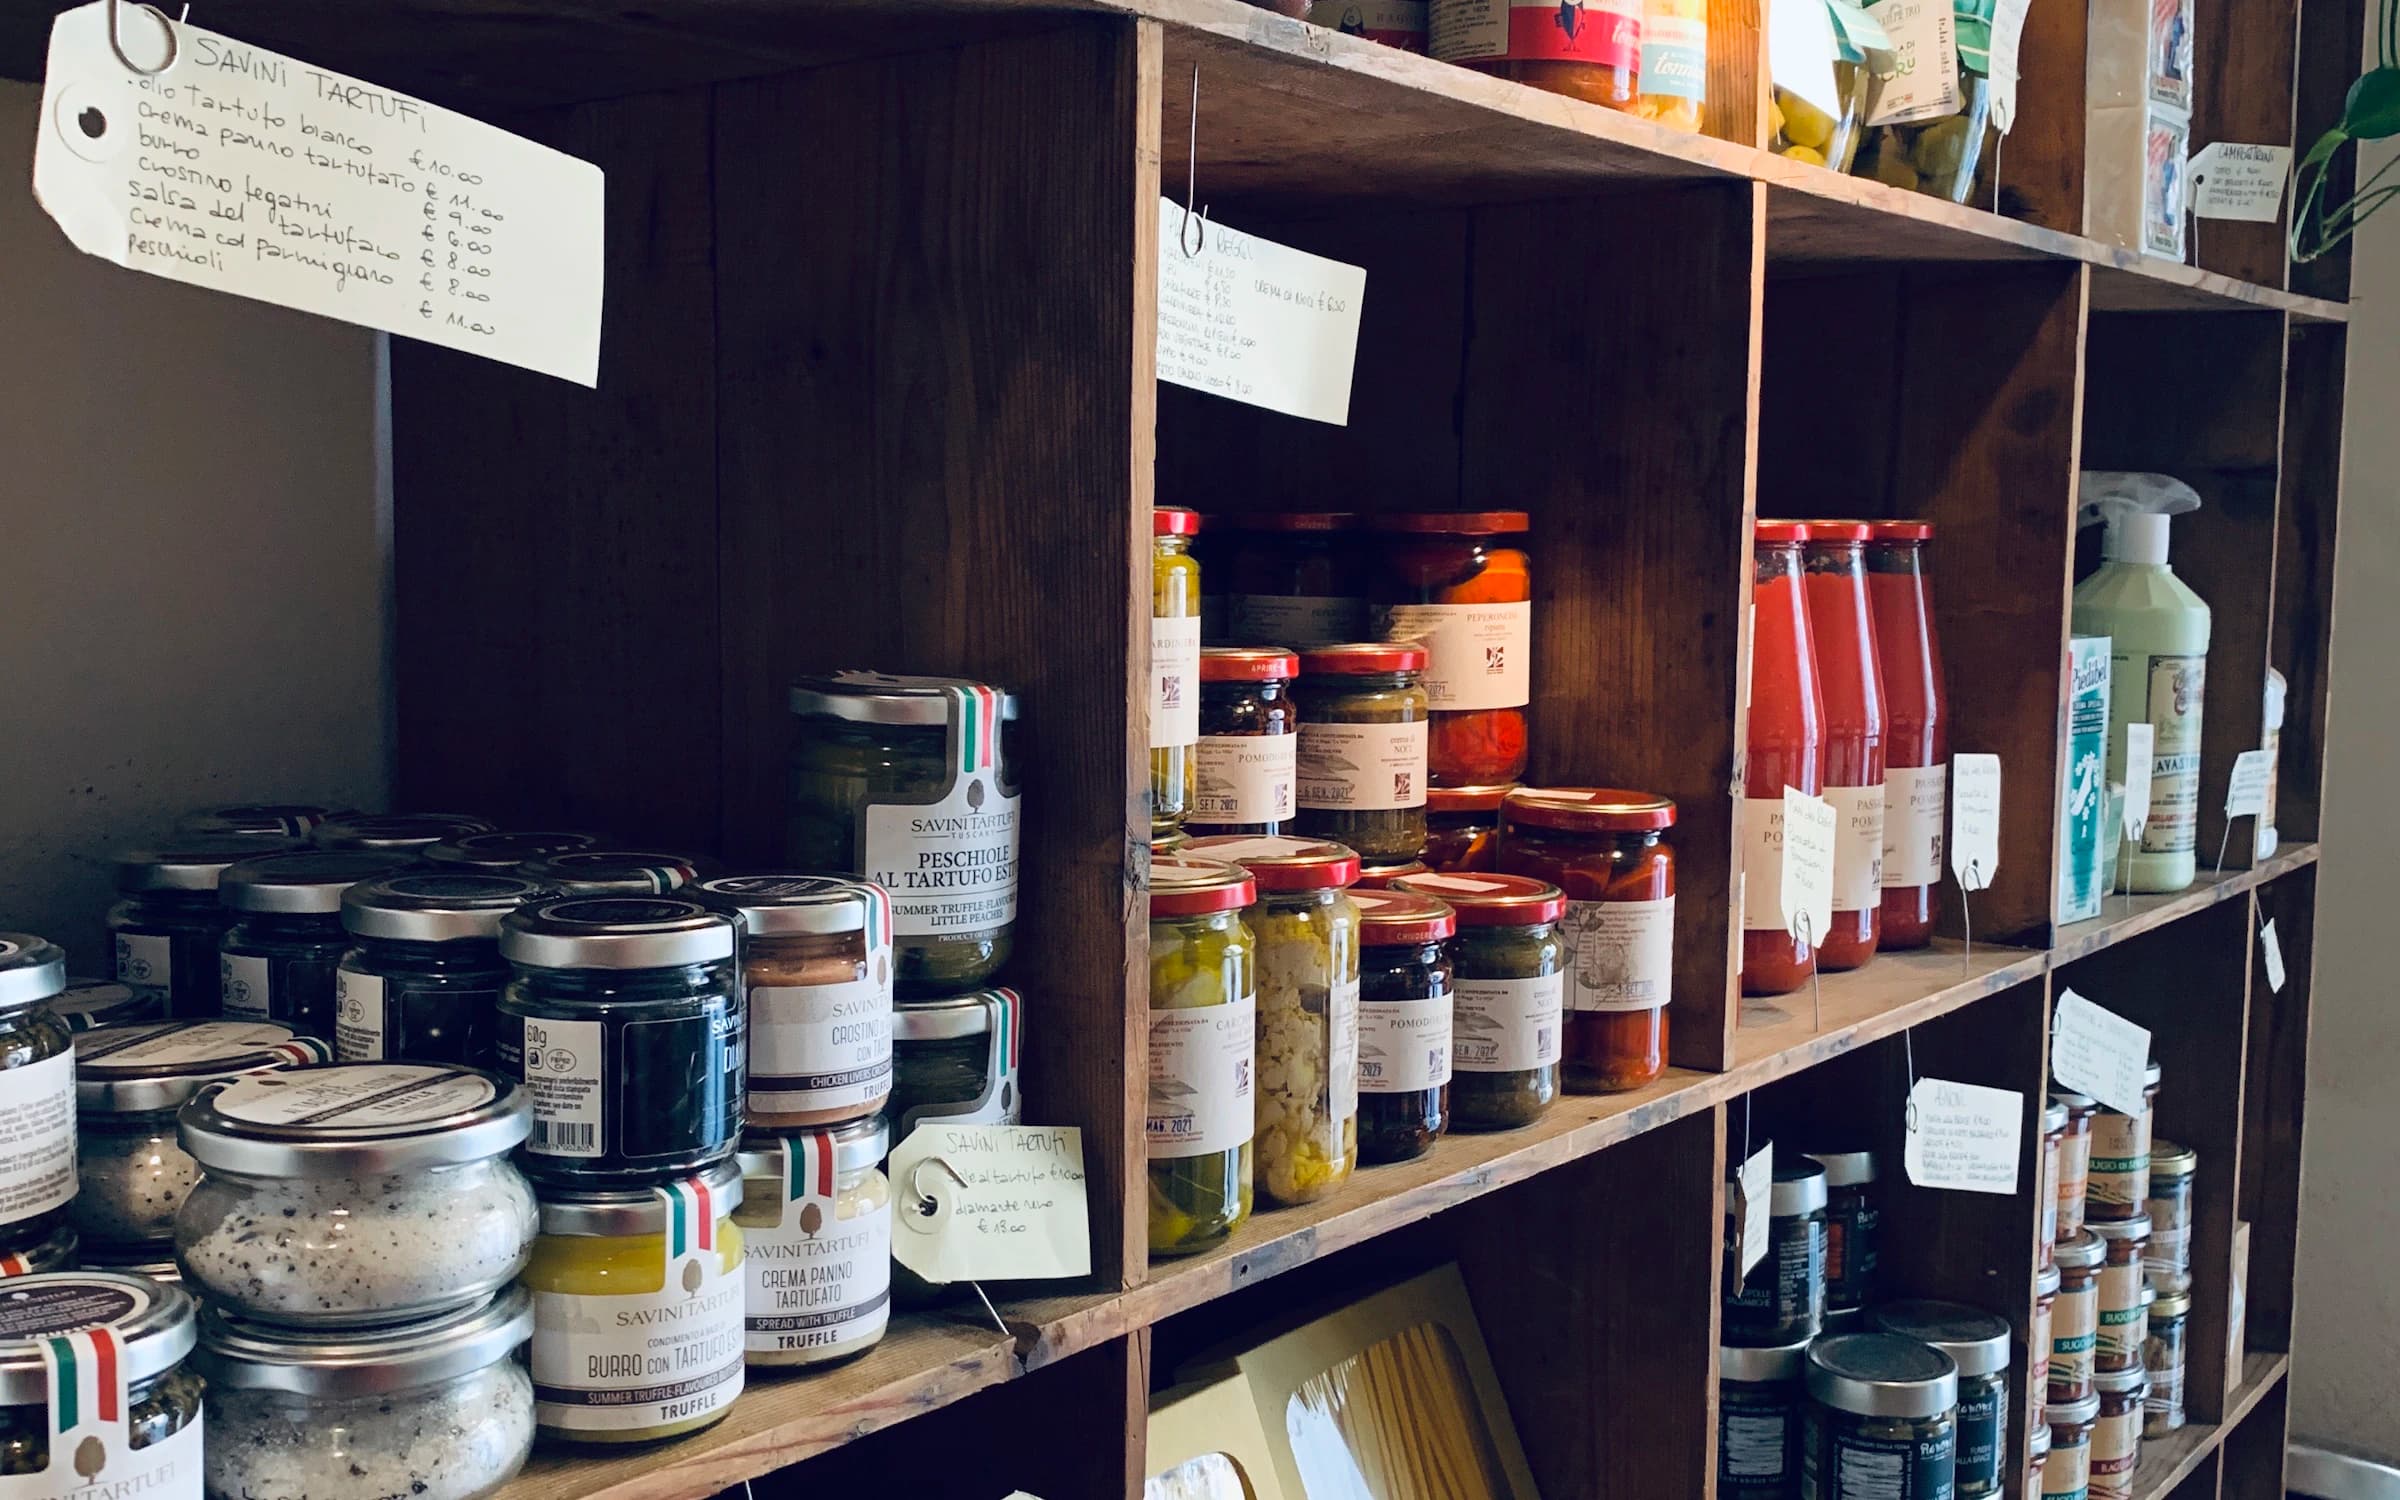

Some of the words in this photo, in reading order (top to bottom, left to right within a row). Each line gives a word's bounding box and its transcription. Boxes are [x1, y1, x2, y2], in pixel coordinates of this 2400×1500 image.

[911, 818, 968, 833] SAVINI
[917, 845, 1010, 869] PESCHIOLE
[874, 871, 900, 888] AL
[904, 866, 993, 889] TARTUFO
[930, 914, 968, 927] LITTLE
[810, 1073, 849, 1089] CHICKEN
[1171, 1119, 1192, 1133] 2021
[761, 1268, 807, 1289] CREMA
[810, 1260, 853, 1286] PANINO
[775, 1283, 842, 1310] TARTUFATO
[616, 1305, 684, 1327] SAVINI
[756, 1316, 794, 1331] SPREAD
[777, 1329, 838, 1349] TRUFFLE
[588, 1353, 643, 1378] BURRO
[647, 1356, 670, 1375] CON
[675, 1333, 727, 1371] TARTUFO
[588, 1389, 633, 1405] SUMMER
[660, 1392, 717, 1420] TRUFFLE
